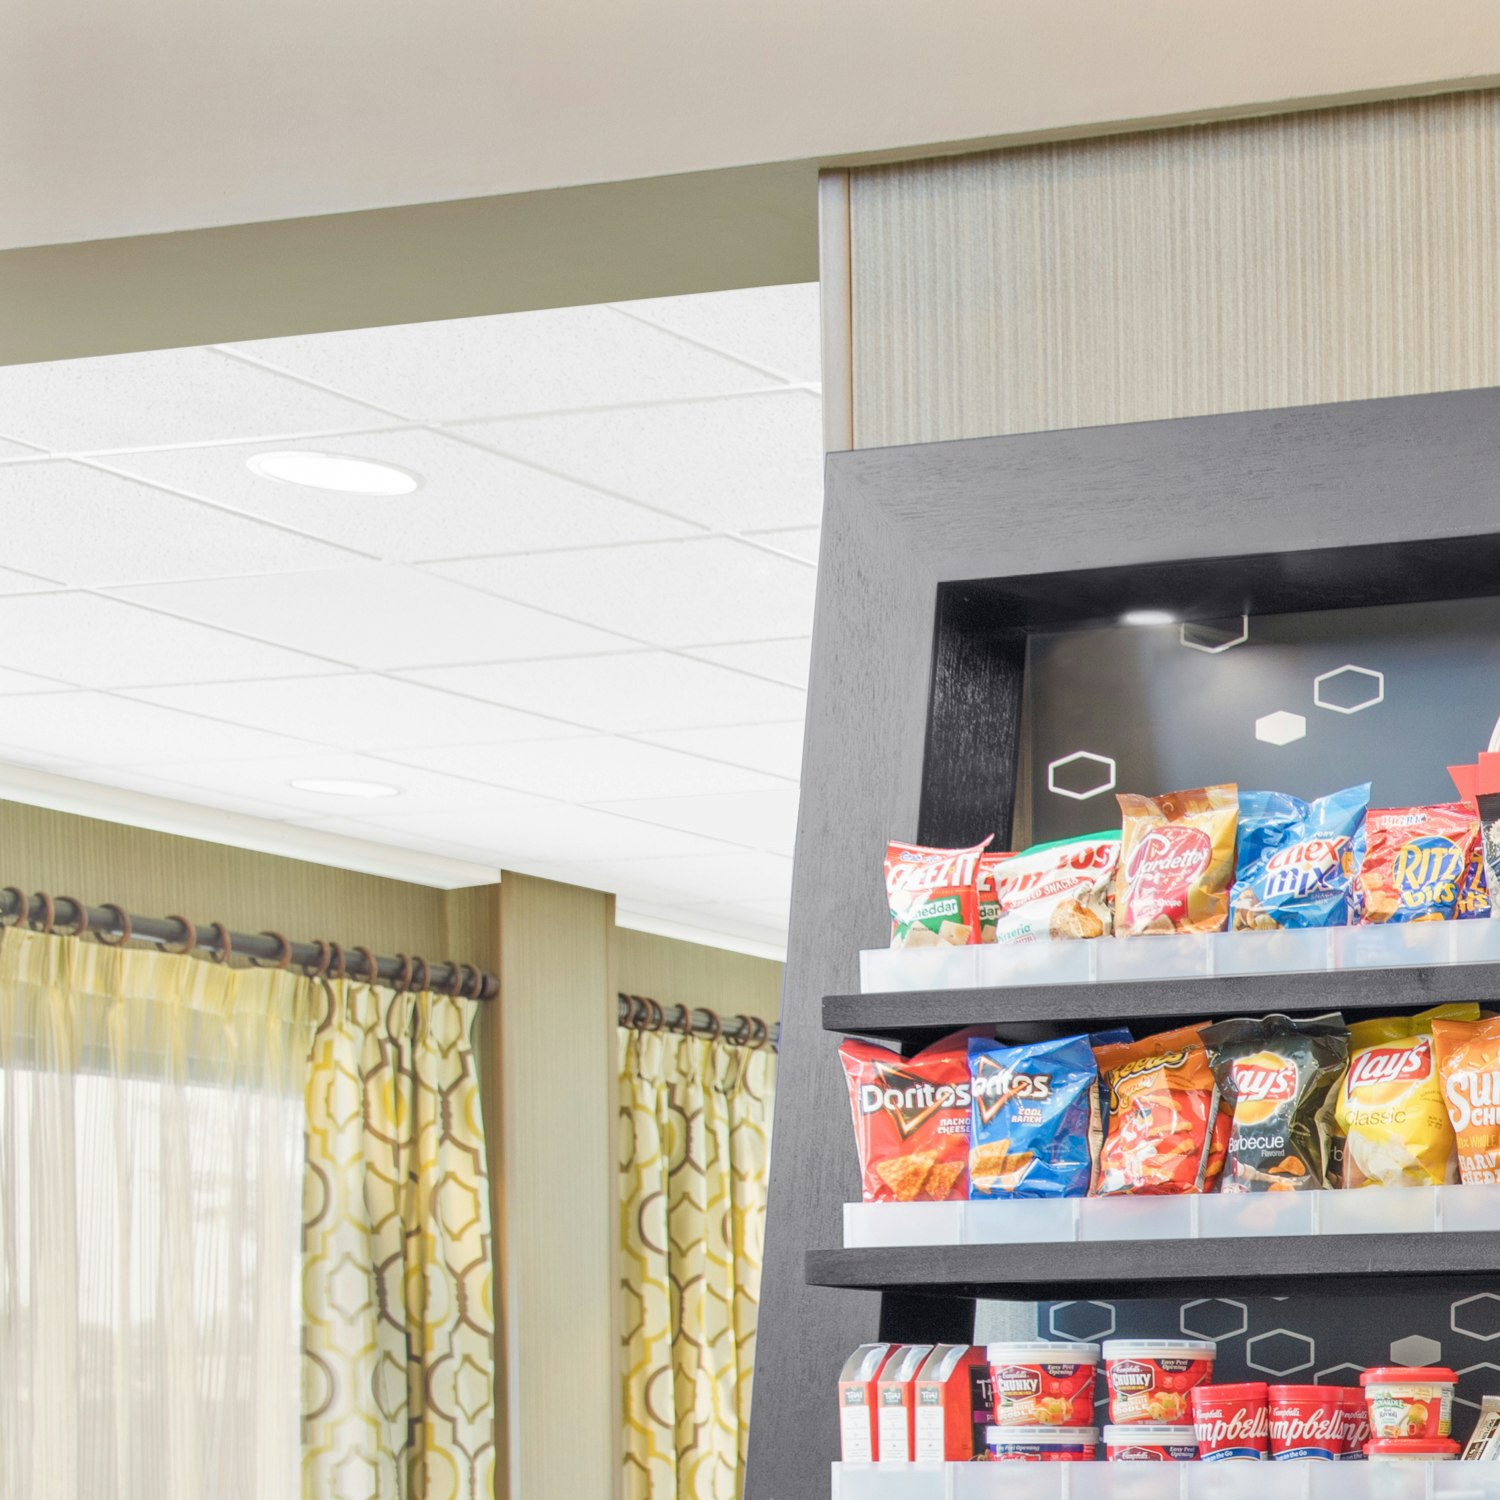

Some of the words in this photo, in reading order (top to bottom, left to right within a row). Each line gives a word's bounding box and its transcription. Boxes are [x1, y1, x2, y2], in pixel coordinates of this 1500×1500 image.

[1398, 844, 1463, 891] RITZ
[1403, 881, 1458, 909] bits
[1236, 1064, 1295, 1099] ay's
[1348, 1044, 1428, 1090] Lay's
[861, 1083, 970, 1113] Doritos
[972, 1068, 1050, 1099] oritos
[1344, 1108, 1407, 1127] Classic
[1228, 1134, 1284, 1153] Barbecue
[996, 1377, 1039, 1393] CHUNKY
[1112, 1373, 1151, 1387] CHUNKY
